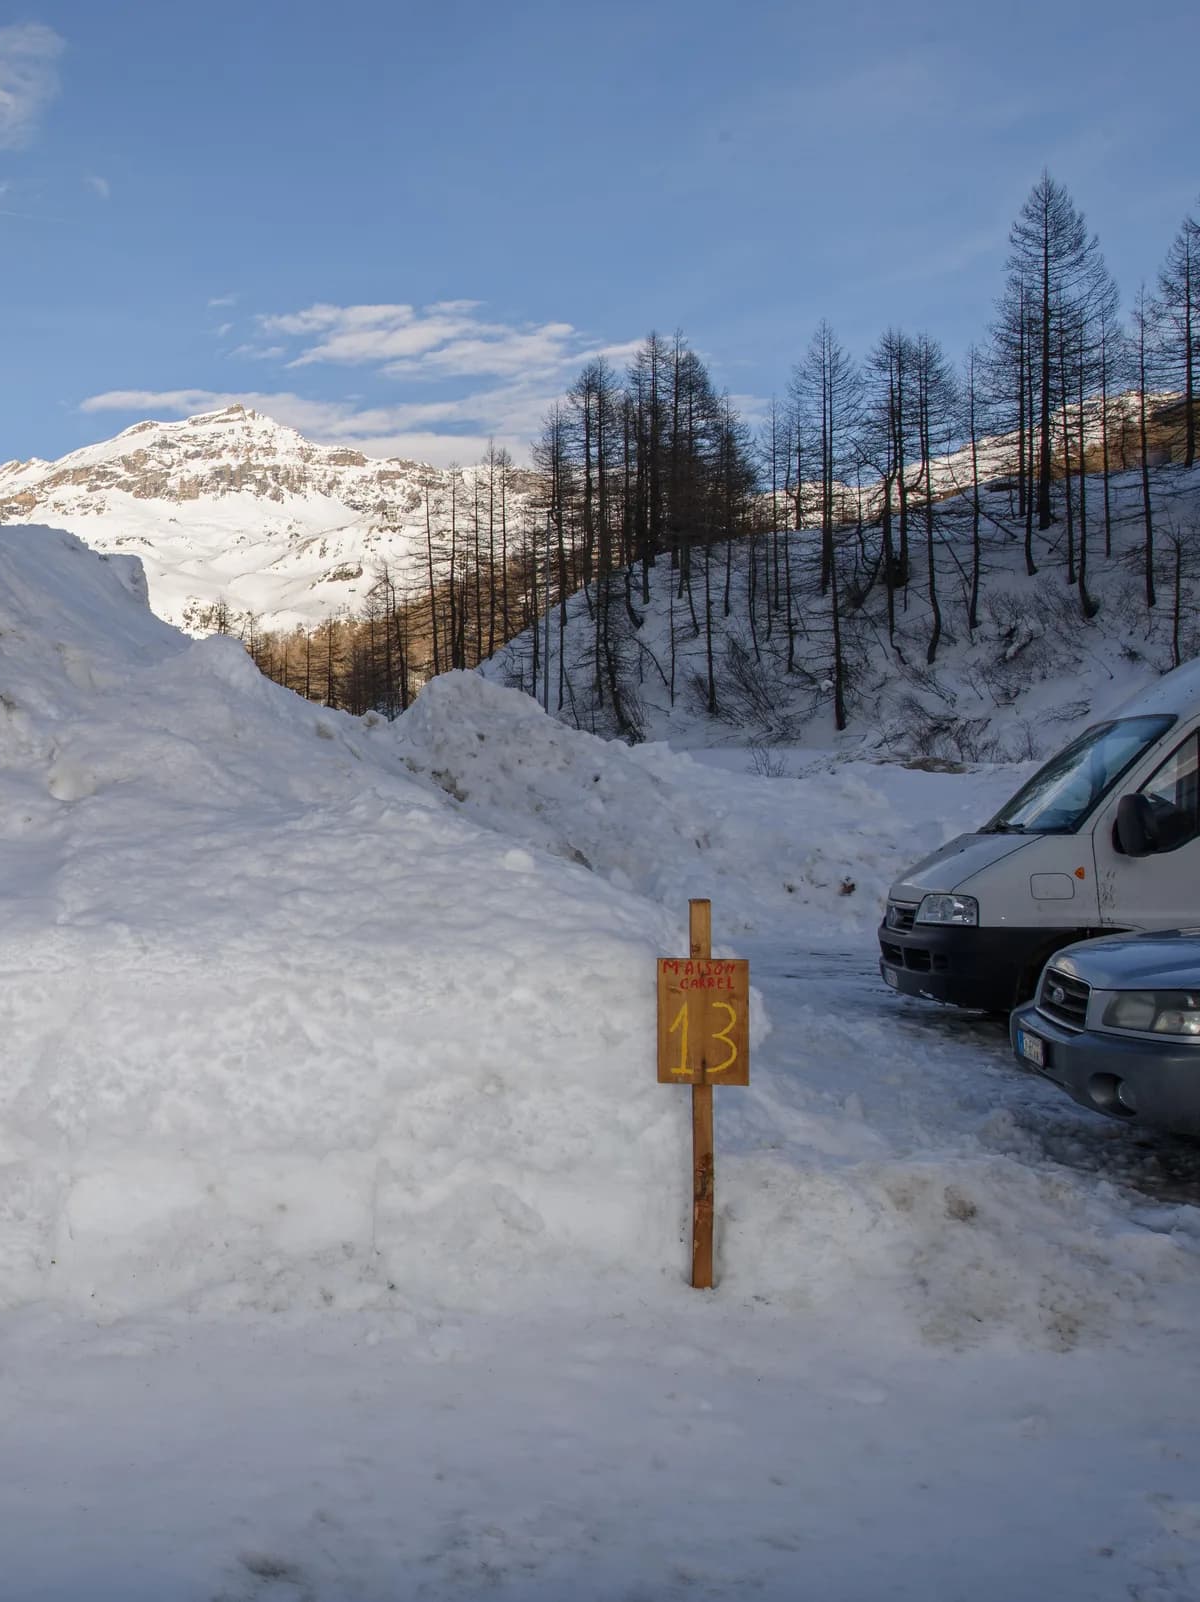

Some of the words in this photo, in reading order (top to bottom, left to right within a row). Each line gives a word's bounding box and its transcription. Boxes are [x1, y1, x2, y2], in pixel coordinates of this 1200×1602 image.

[663, 960, 736, 976] MAISON
[680, 976, 735, 991] CARREL
[669, 1001, 737, 1075] 13
